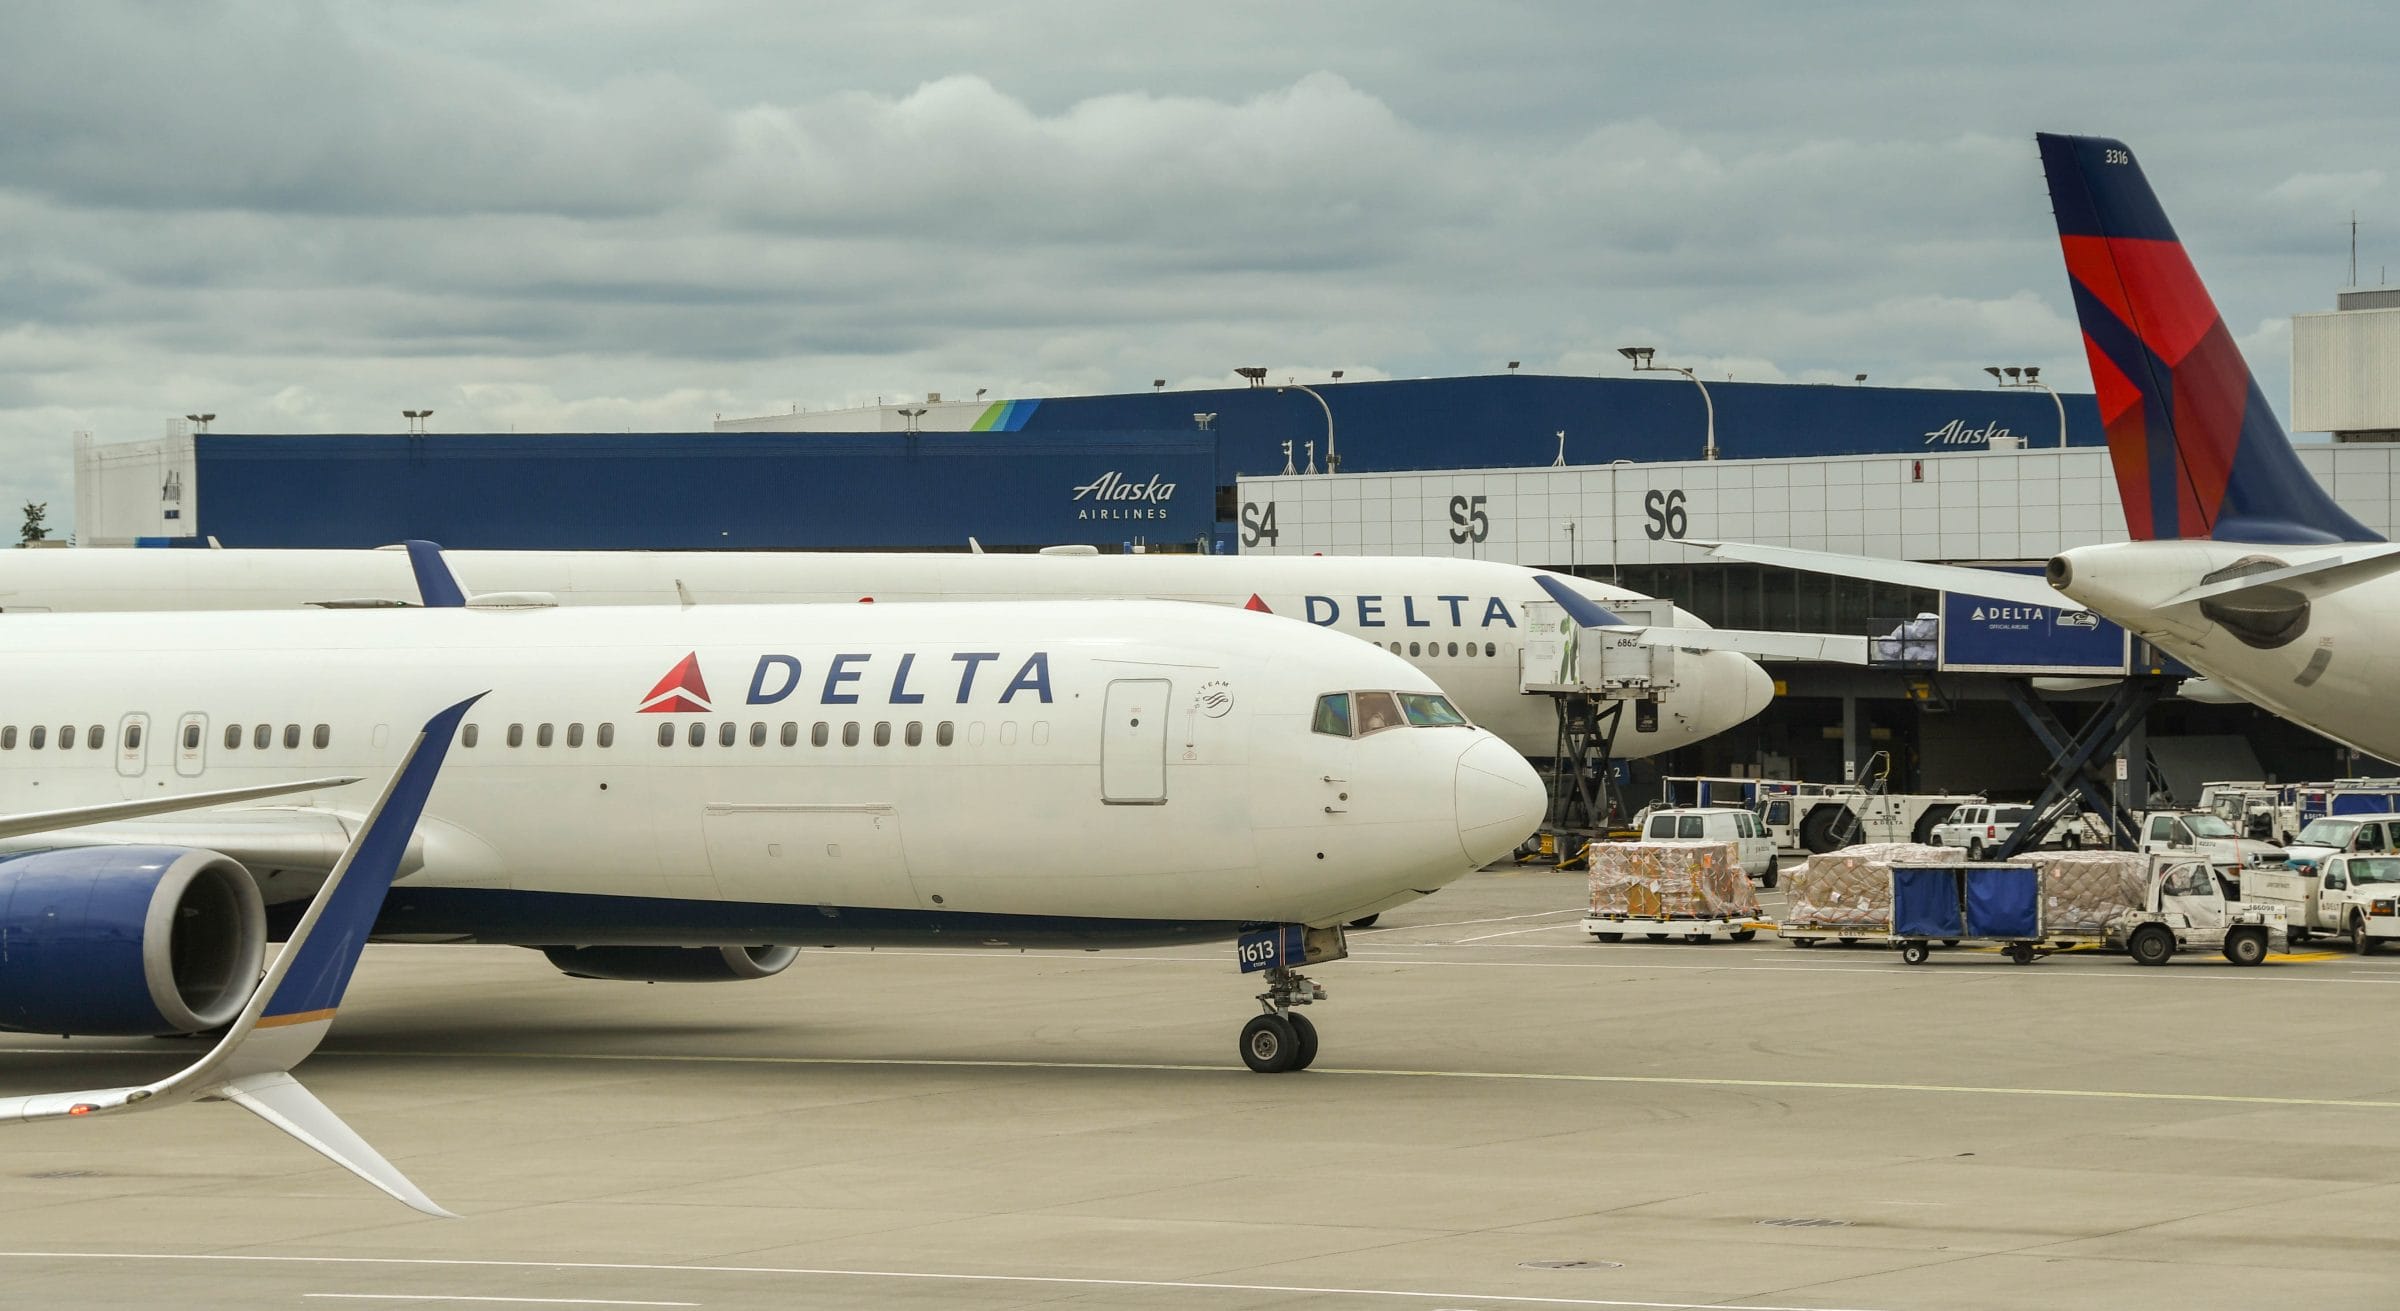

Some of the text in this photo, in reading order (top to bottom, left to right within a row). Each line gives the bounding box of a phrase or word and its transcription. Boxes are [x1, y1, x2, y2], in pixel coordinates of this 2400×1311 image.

[2105, 149, 2129, 165] 3316
[1924, 419, 2010, 444] Alaska
[1072, 471, 1176, 504] Alaska
[1078, 509, 1167, 519] AIRLINES
[1241, 501, 1278, 547] S4
[1449, 495, 1488, 544] S5
[1645, 489, 1687, 540] S6
[1304, 595, 1517, 628] DELTA
[1990, 608, 2043, 619] DELTA
[745, 651, 1054, 705] DELTA
[1238, 940, 1275, 963] 1613
